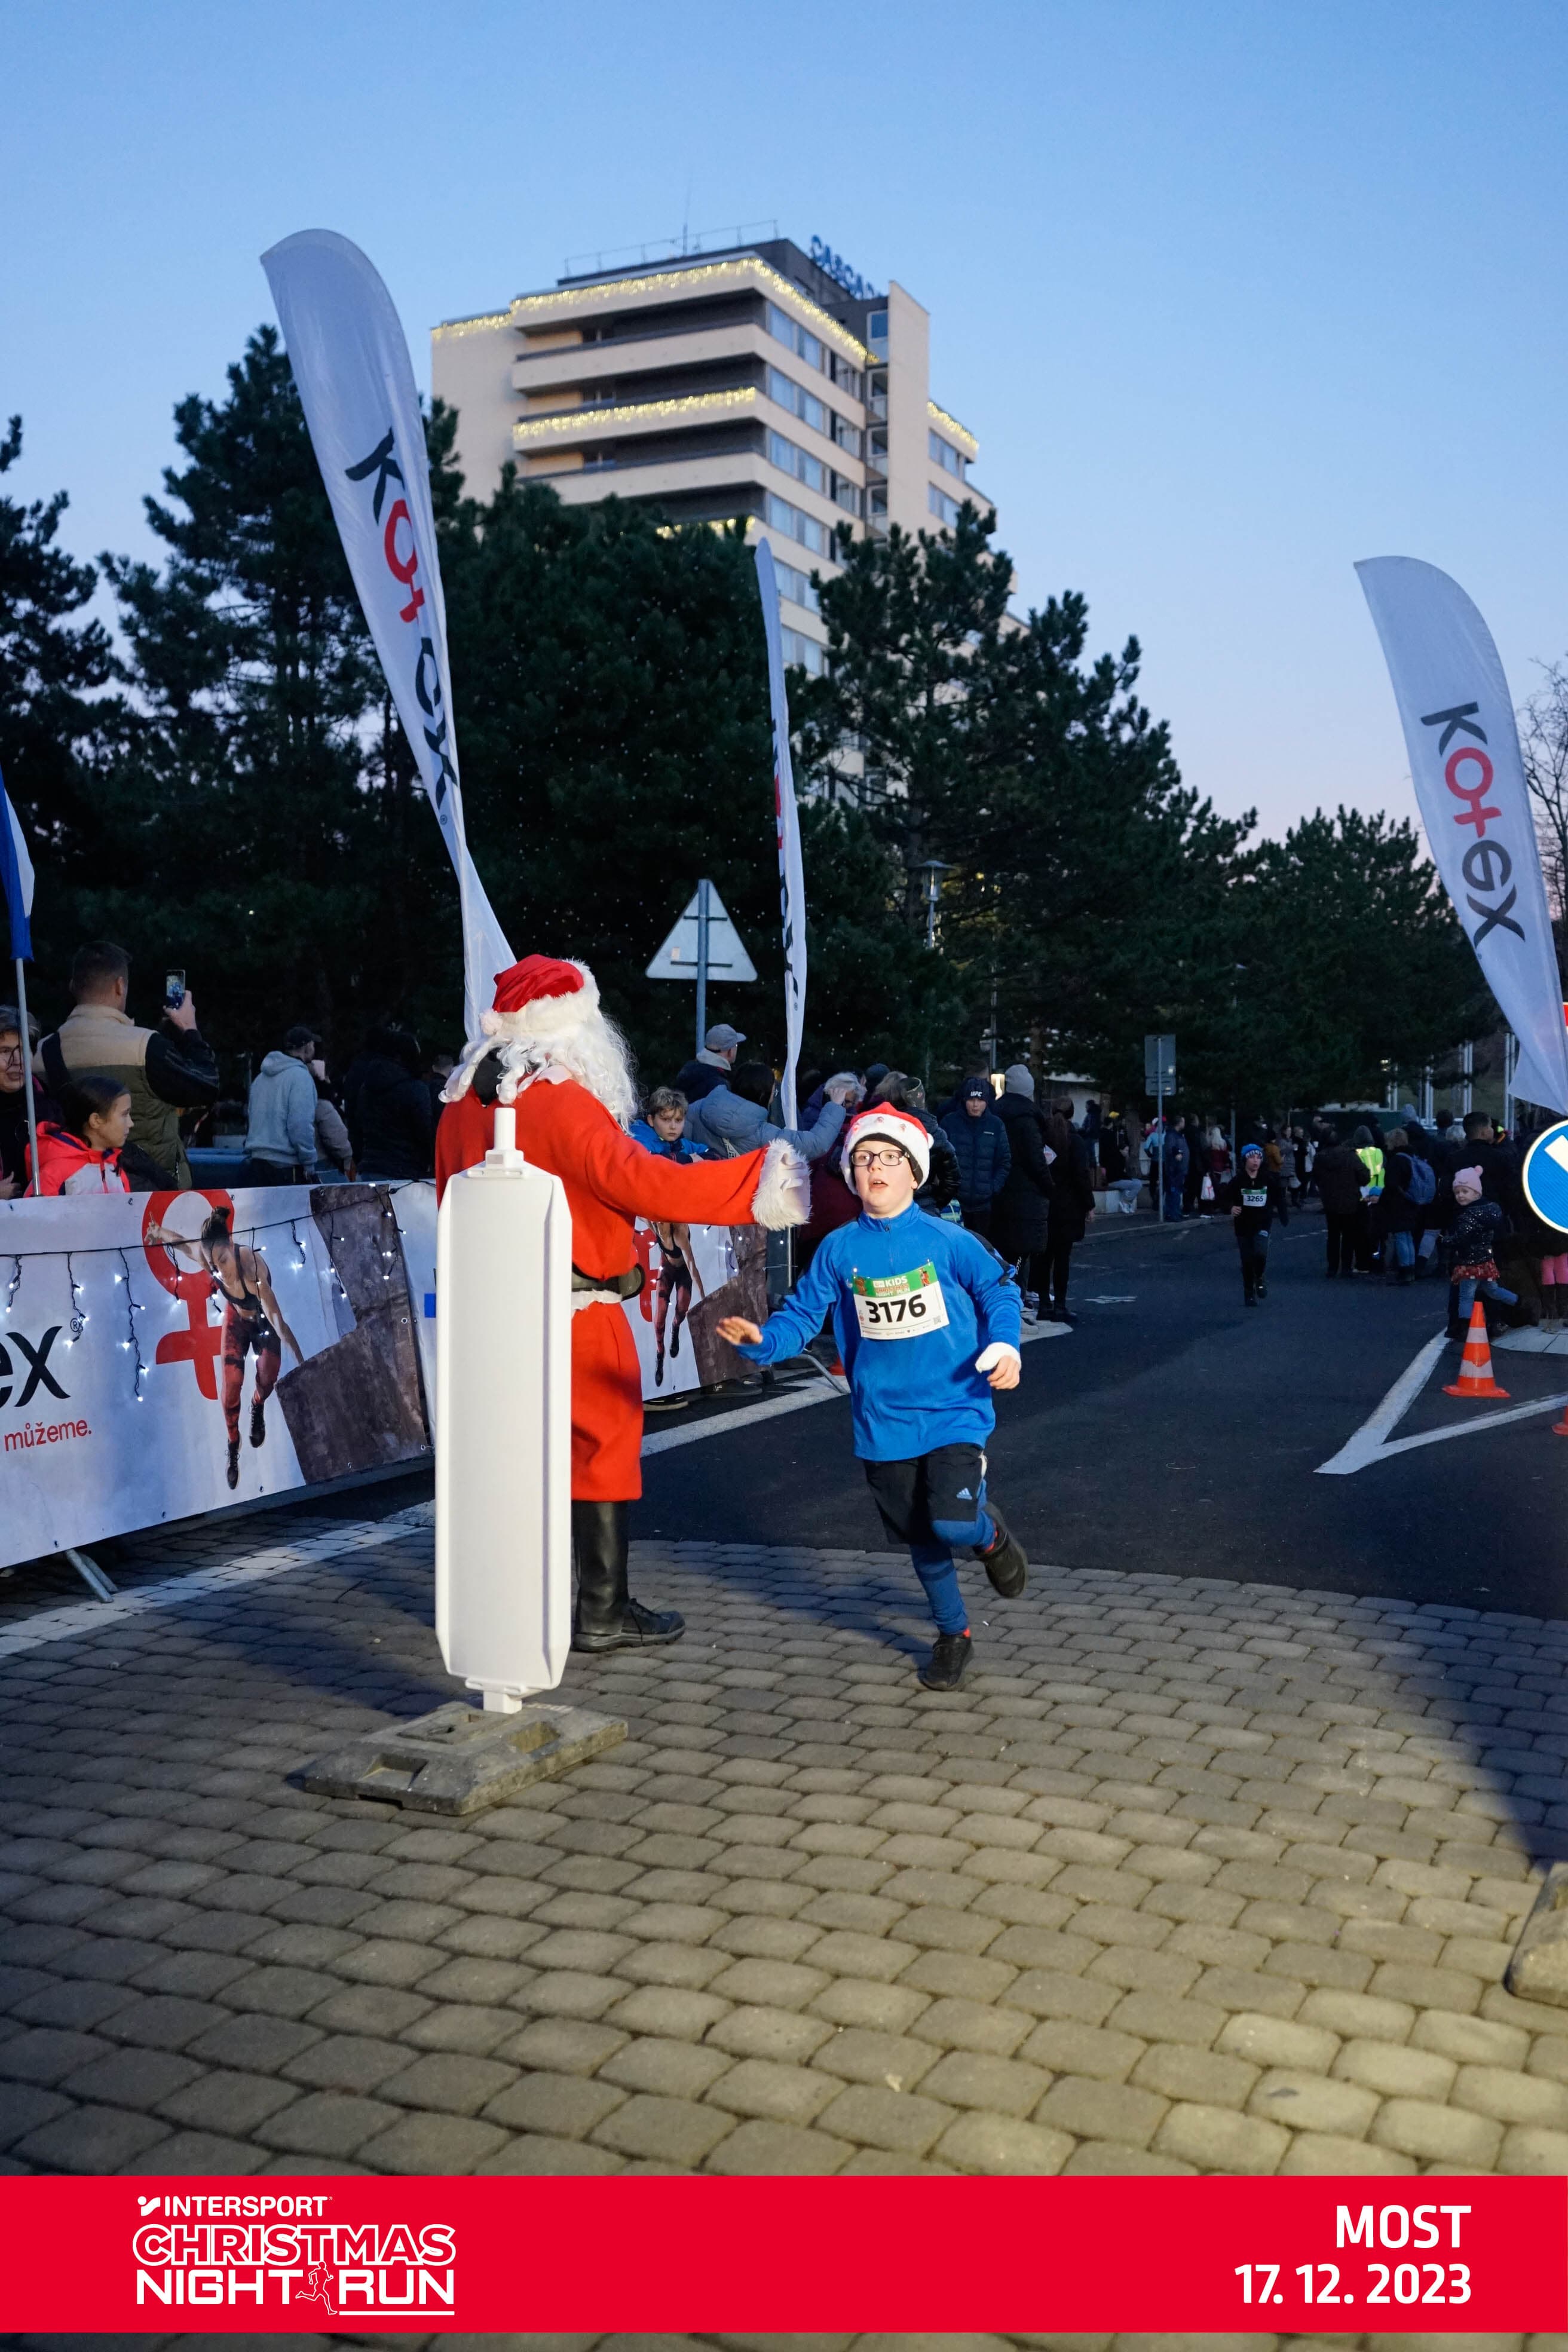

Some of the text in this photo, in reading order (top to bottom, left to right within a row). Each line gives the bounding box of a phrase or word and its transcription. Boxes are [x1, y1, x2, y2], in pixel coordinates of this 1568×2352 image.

[1420, 701, 1526, 949] Kotex
[884, 1275, 908, 1288] KIDS
[865, 1294, 927, 1324] 3176
[4, 1419, 92, 1452] můžeme.
